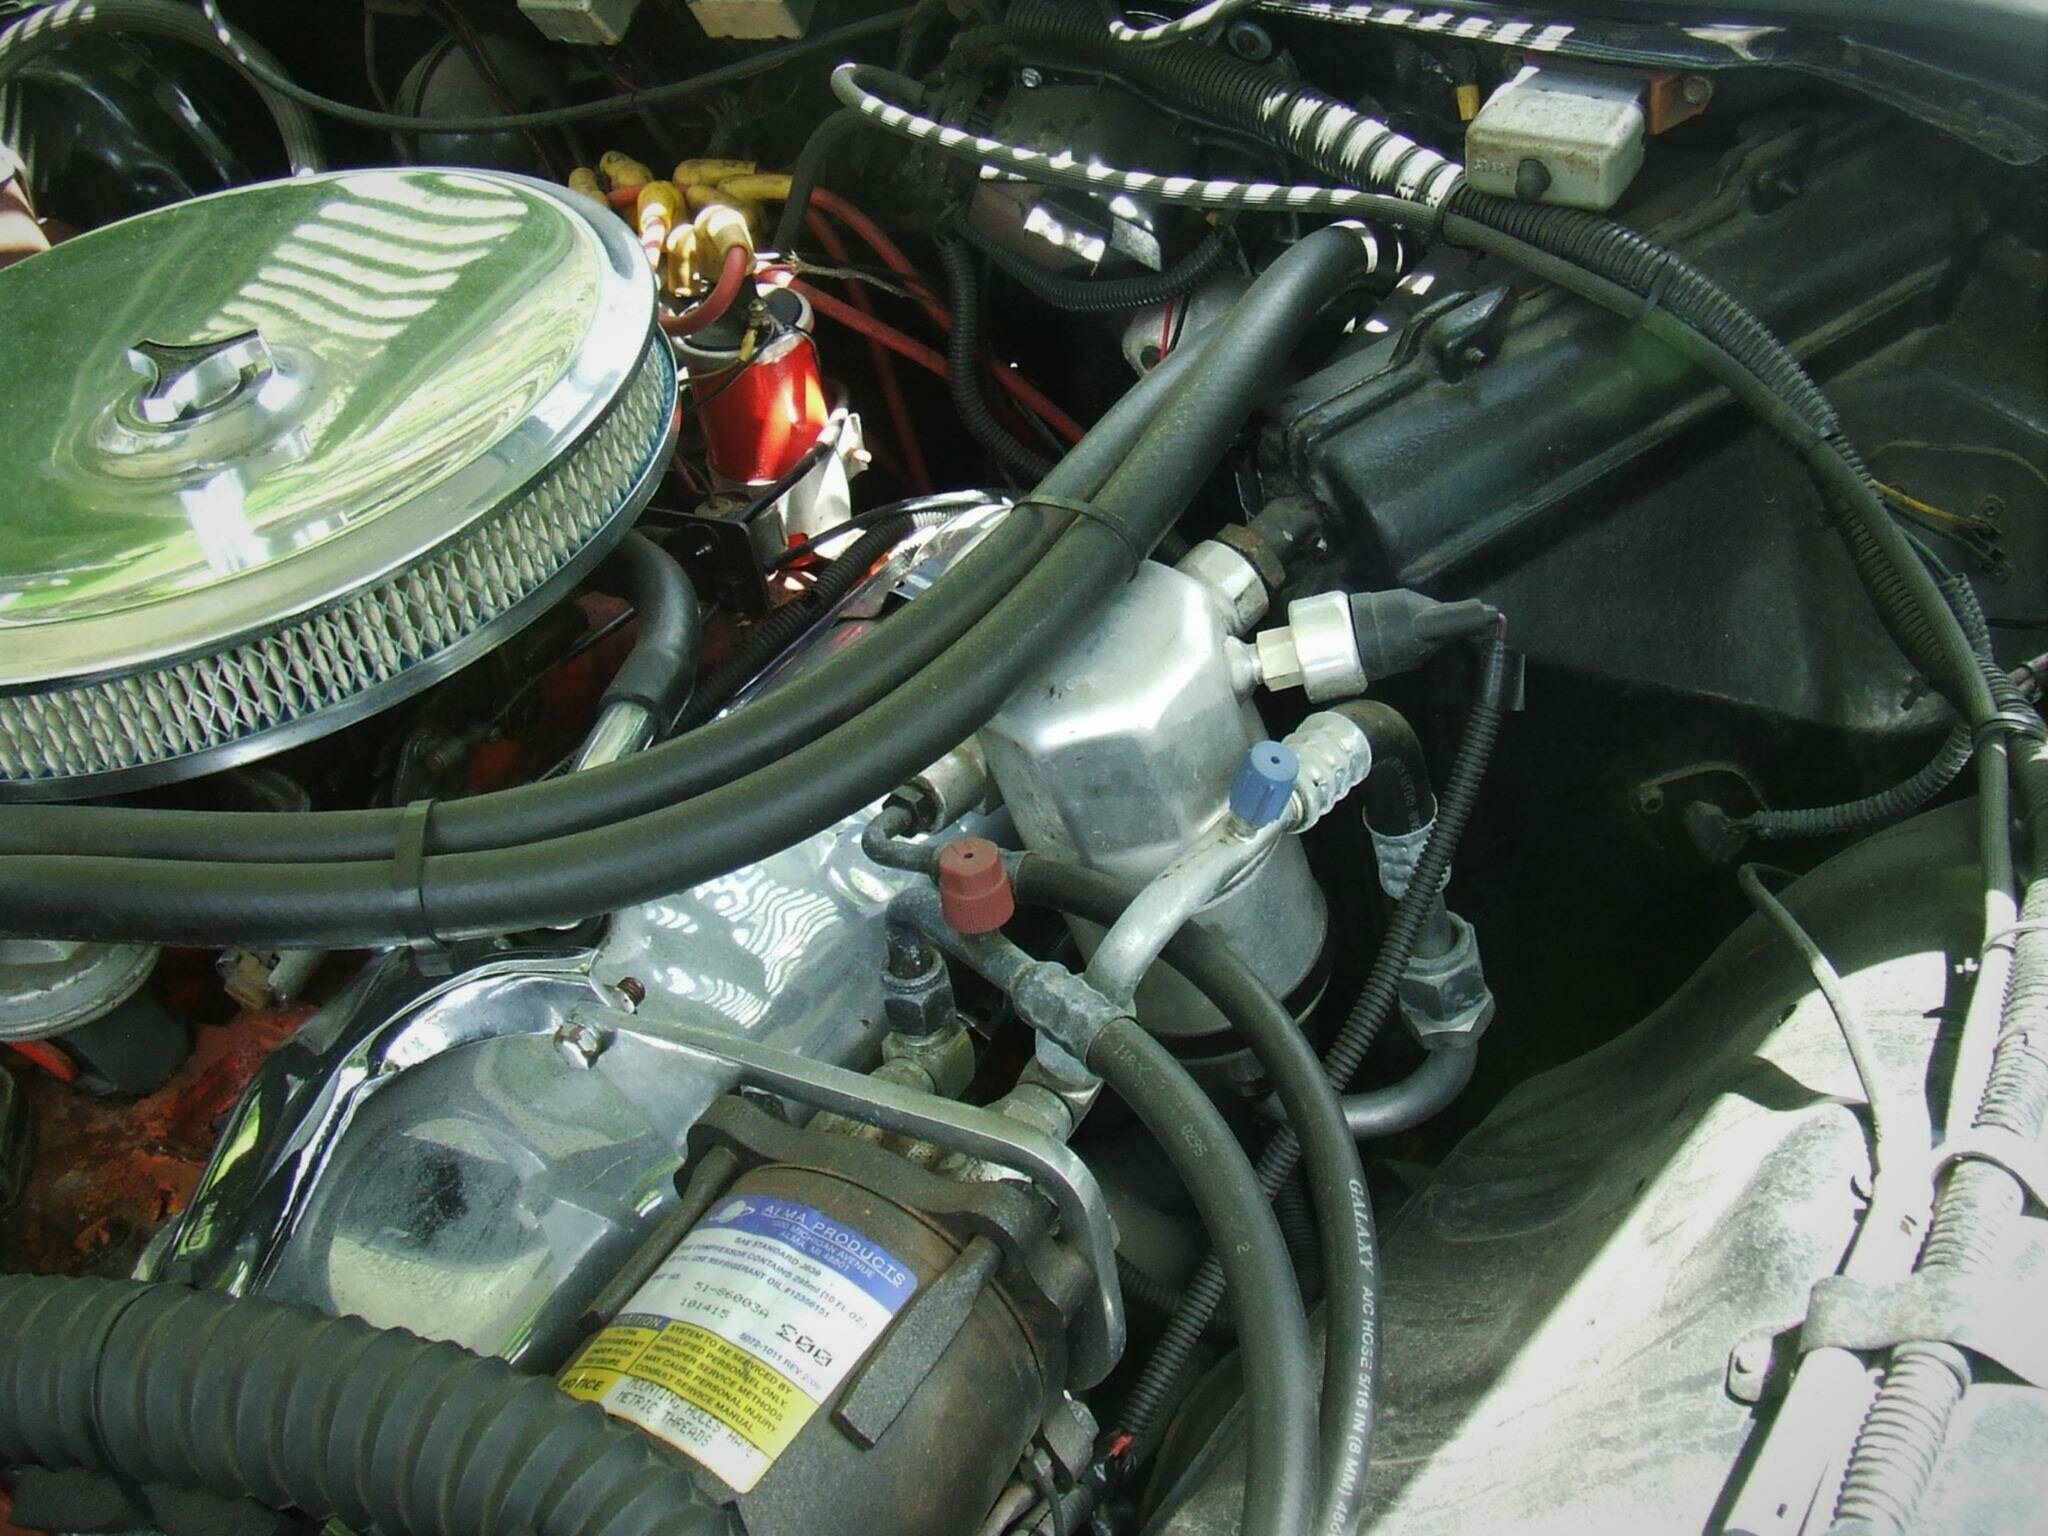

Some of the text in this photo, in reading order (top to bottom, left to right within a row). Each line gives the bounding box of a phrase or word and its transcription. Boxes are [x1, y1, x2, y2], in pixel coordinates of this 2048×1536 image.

[748, 1252, 794, 1279] CONTAINS
[752, 1238, 800, 1266] STANDARD
[764, 1205, 906, 1285] ALMA PRODUCTS
[790, 1224, 838, 1255] MICHIGAN
[837, 1247, 875, 1280] AVENUE
[708, 1256, 767, 1281] REFRIGERANT
[766, 1276, 784, 1292] OIL
[634, 1362, 675, 1383] CONSULT
[674, 1376, 714, 1405] SERVICE
[652, 1343, 784, 1422] IMPROPER SERVICE METHODS
[660, 1334, 705, 1355] QUALIFIED
[705, 1351, 761, 1391] PERSONNEL
[669, 1324, 793, 1395] SYSTEM TO BE SERVICED BY
[1327, 1179, 1374, 1536] GALAXY A/C HOSE 5/16 IN (8 MM) 486
[615, 1391, 713, 1447] METRIC THREADS
[643, 1353, 664, 1364] MAY
[662, 1356, 694, 1376] CAUSE
[693, 1371, 742, 1409] PERSONAL
[742, 1404, 778, 1433] INJURY
[683, 1402, 722, 1433] HOLES
